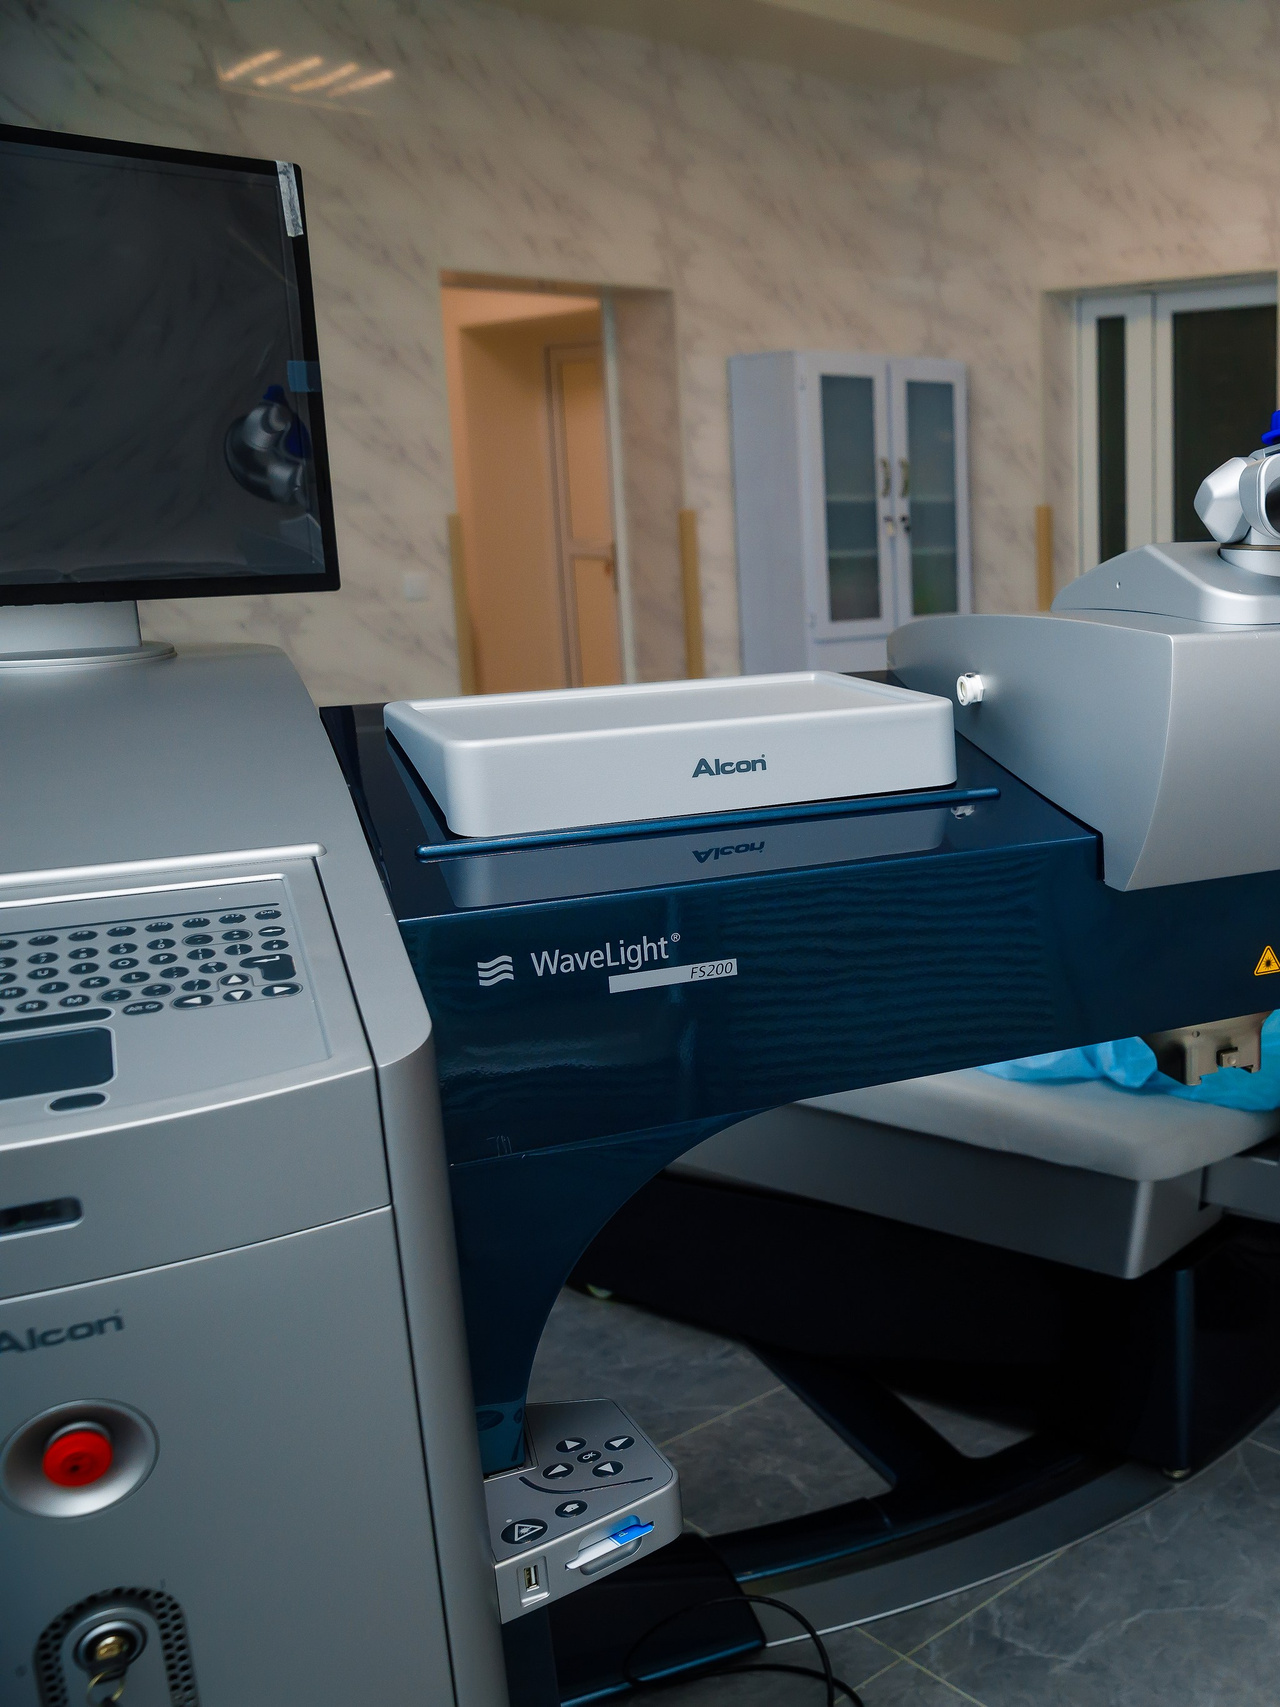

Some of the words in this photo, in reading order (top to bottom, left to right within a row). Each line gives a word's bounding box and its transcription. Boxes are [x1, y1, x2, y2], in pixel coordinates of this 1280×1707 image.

[691, 755, 767, 778] Alcon
[690, 962, 733, 980] FS200
[0, 1310, 124, 1353] Alcon
[582, 1452, 597, 1460] OK
